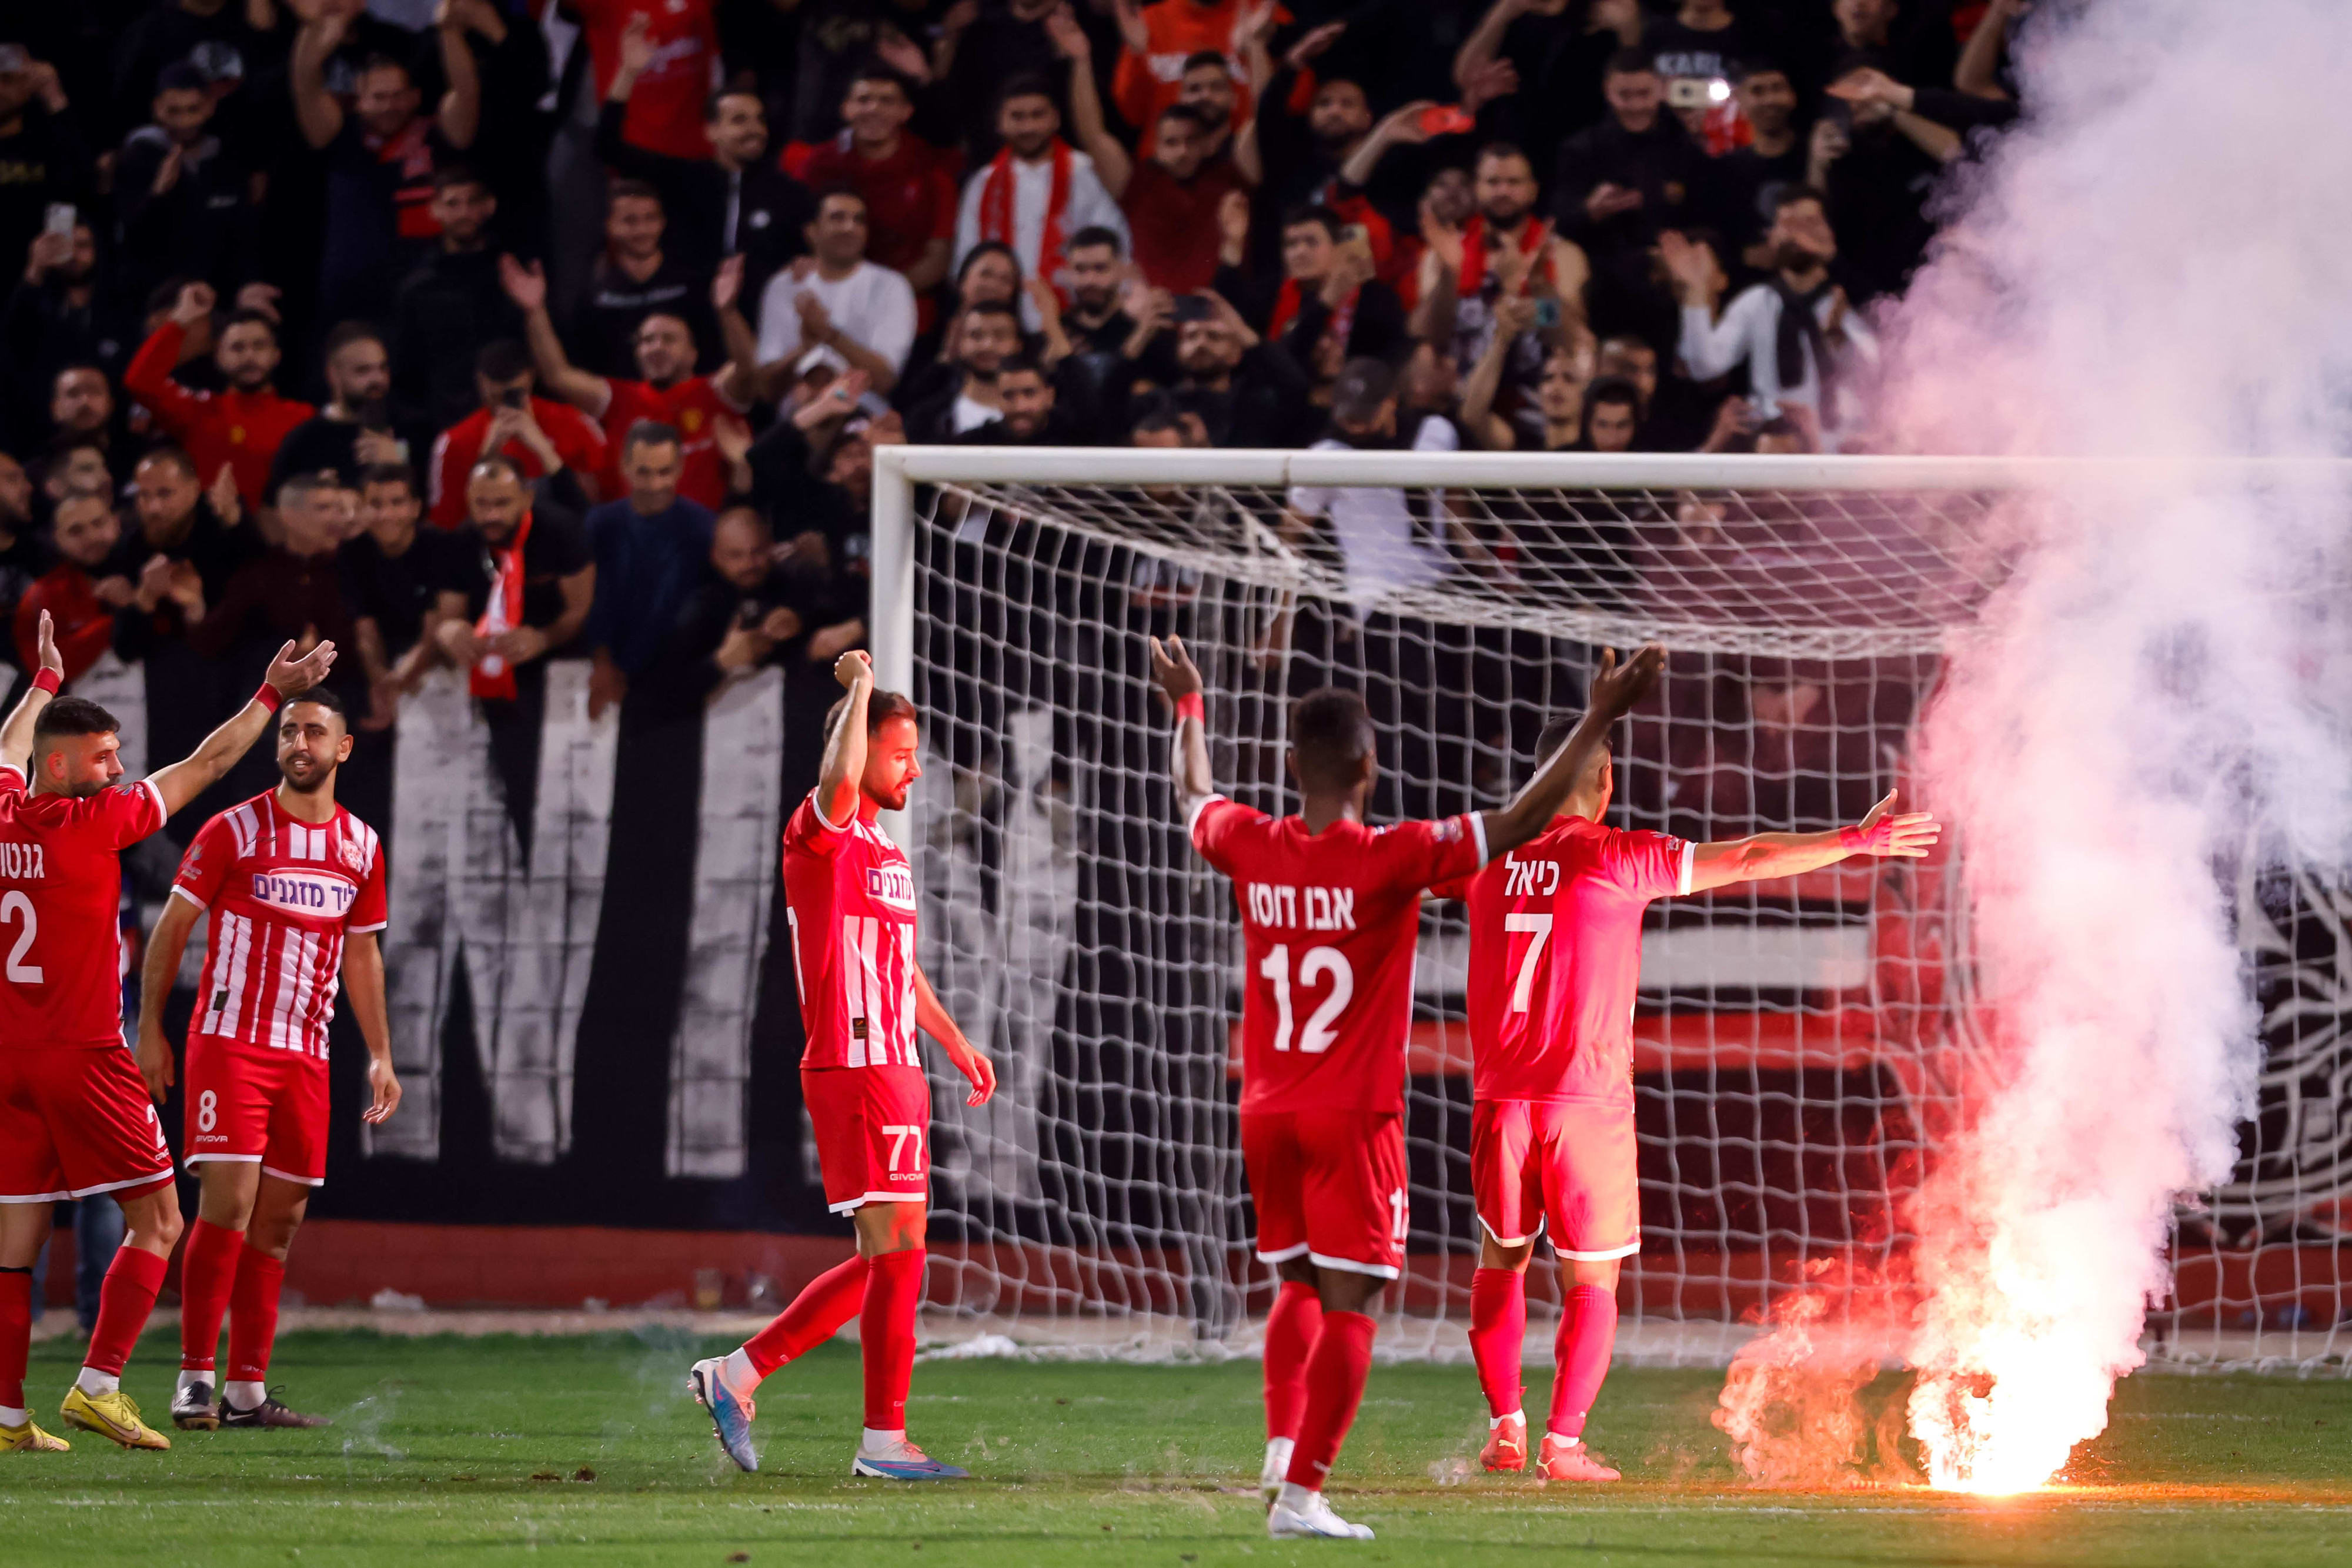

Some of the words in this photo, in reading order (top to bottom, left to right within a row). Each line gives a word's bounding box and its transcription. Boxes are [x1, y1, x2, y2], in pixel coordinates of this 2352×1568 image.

[0, 842, 45, 879] גנטו
[1505, 851, 1559, 895] כיאל
[254, 874, 325, 907] מזגנים
[1304, 886, 1357, 931] אבו
[1, 890, 44, 984] 2
[1505, 913, 1553, 1012] 7
[1260, 943, 1354, 1053] 12
[146, 1104, 166, 1149] 2
[199, 1089, 217, 1132] 8
[882, 1125, 923, 1171] 77
